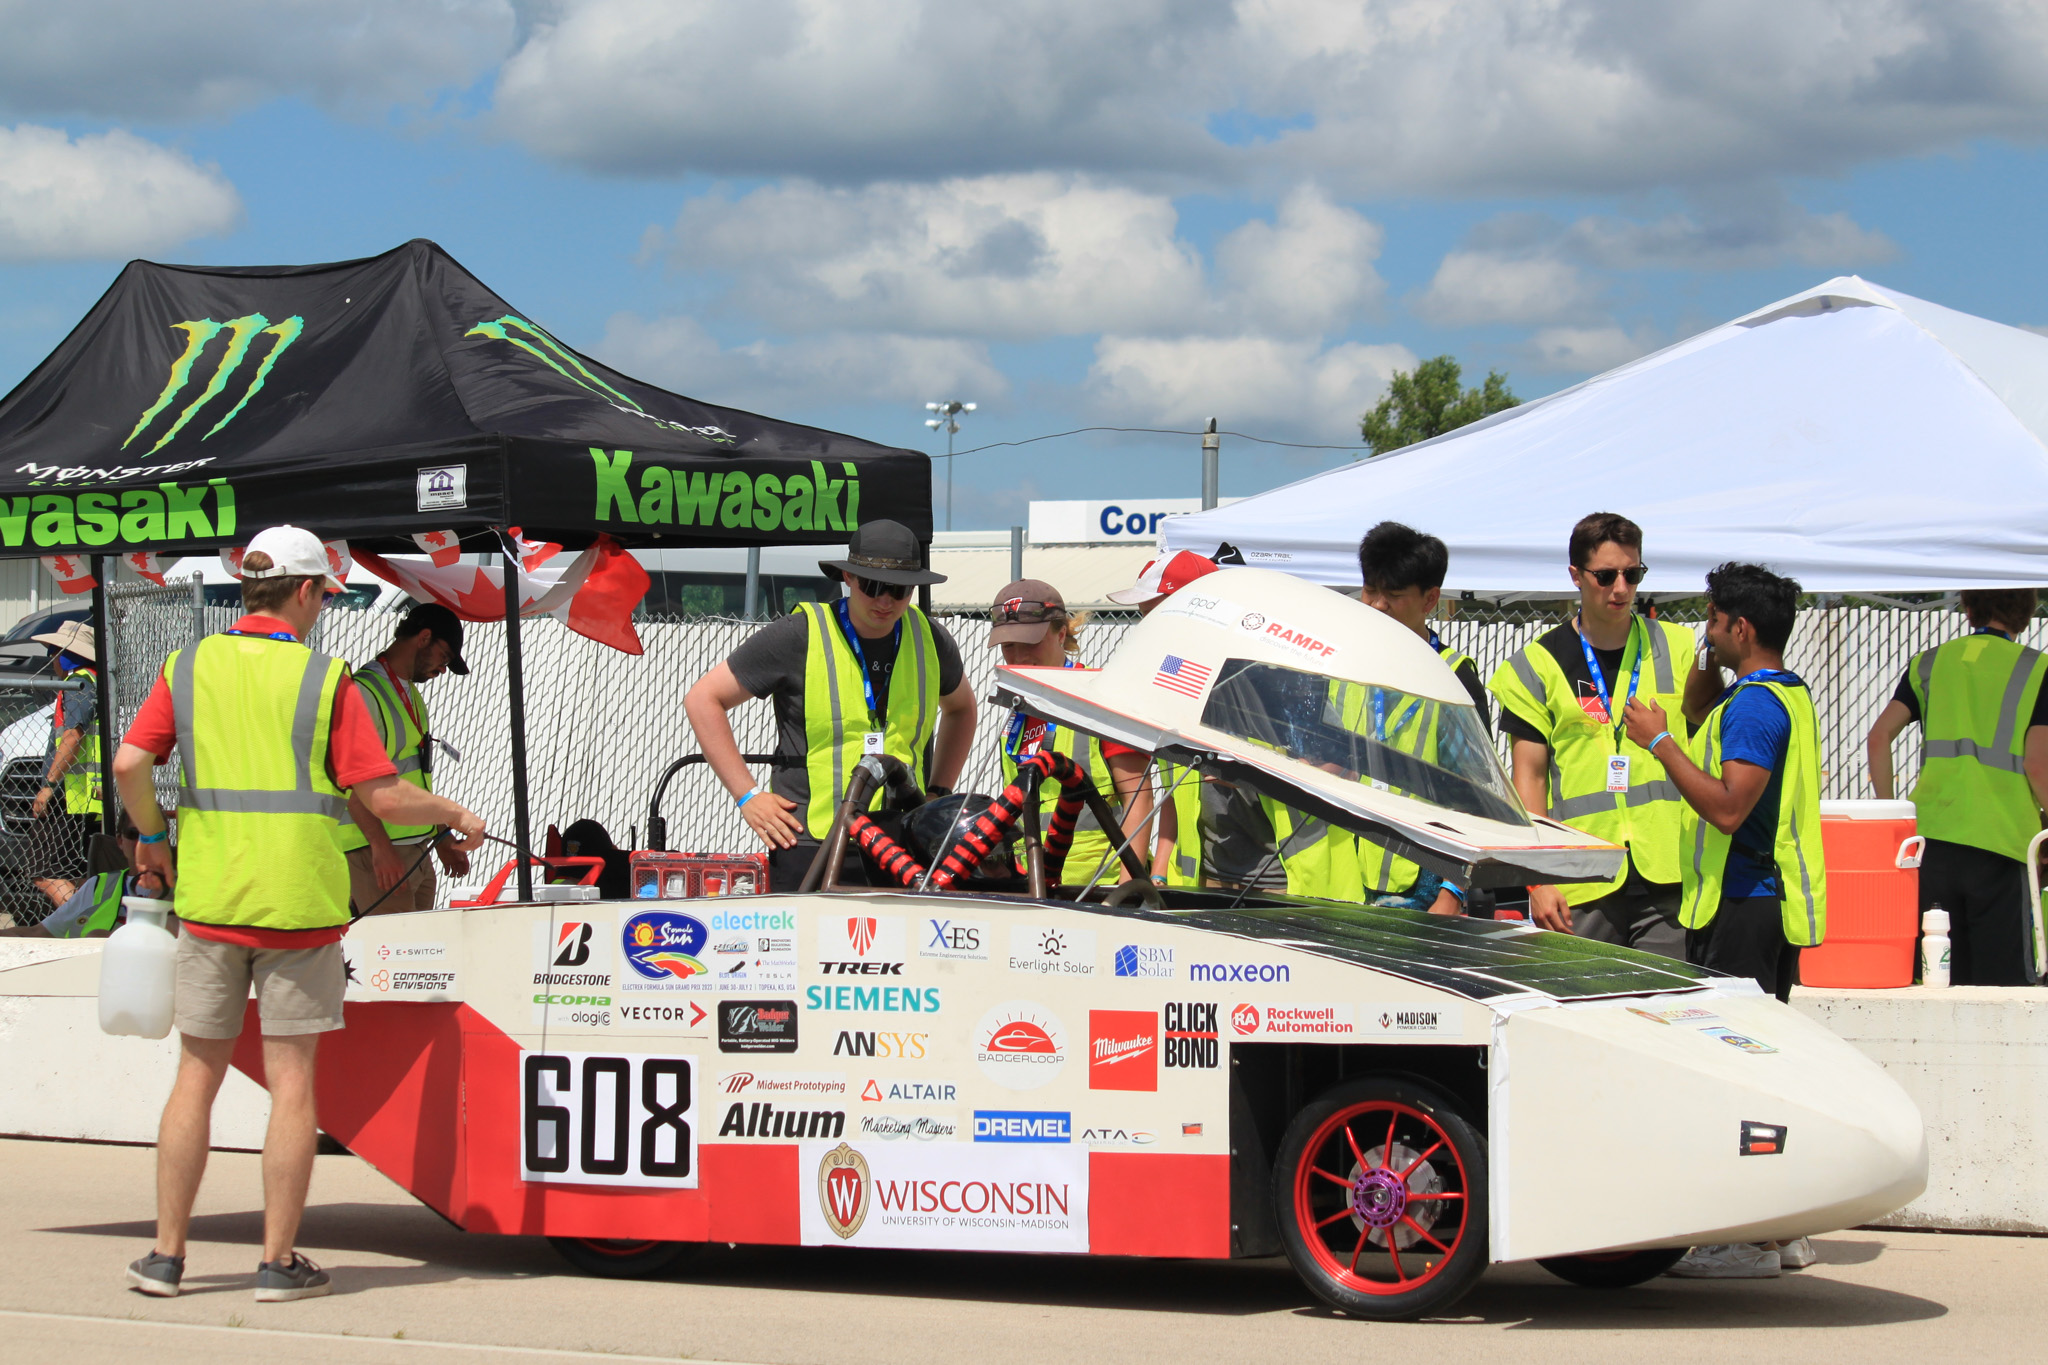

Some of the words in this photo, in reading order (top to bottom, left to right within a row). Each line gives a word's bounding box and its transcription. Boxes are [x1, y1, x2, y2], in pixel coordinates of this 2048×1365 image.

[589, 447, 860, 532] Kawasaki
[1266, 622, 1336, 657] RAMPF
[711, 910, 795, 930] electrek
[660, 921, 693, 946] Sun
[928, 919, 980, 951] X-ES
[1139, 947, 1174, 963] SBM
[819, 961, 904, 975] TREK
[1009, 957, 1060, 974] Everlight
[1063, 961, 1095, 974] Solar
[1139, 962, 1175, 978] Solar
[1190, 963, 1290, 983] maxeon
[393, 972, 456, 982] COMPOSITE
[393, 981, 448, 990] ENVISIONS
[533, 973, 611, 986] BRIDGESTONE
[806, 985, 941, 1013] SIEMENS
[620, 1006, 684, 1021] VECTOR
[1165, 1002, 1219, 1033] CLICK
[1267, 1007, 1334, 1020] Rockwell
[1396, 1012, 1438, 1025] MADISON
[1266, 1021, 1354, 1033] Automation
[833, 1031, 927, 1059] ANSYS
[1092, 1034, 1154, 1059] Milwaukee
[1165, 1037, 1219, 1069] BOND
[977, 1053, 1065, 1064] BADGERLOOP
[757, 1079, 793, 1092] Midwest
[794, 1080, 846, 1093] Prototyping
[889, 1083, 956, 1101] ALTAIR
[525, 1055, 692, 1178] 608
[718, 1102, 846, 1138] Altium
[861, 1115, 911, 1140] Marketing
[916, 1115, 954, 1137] Masters
[974, 1118, 1070, 1138] DREMEL
[1082, 1128, 1128, 1140] ATA
[875, 1179, 1070, 1216] WISCONSIN
[882, 1216, 940, 1227] UNIVERSITY
[943, 1217, 956, 1227] OF
[958, 1218, 1070, 1230] WISCONSIN-MADISON
